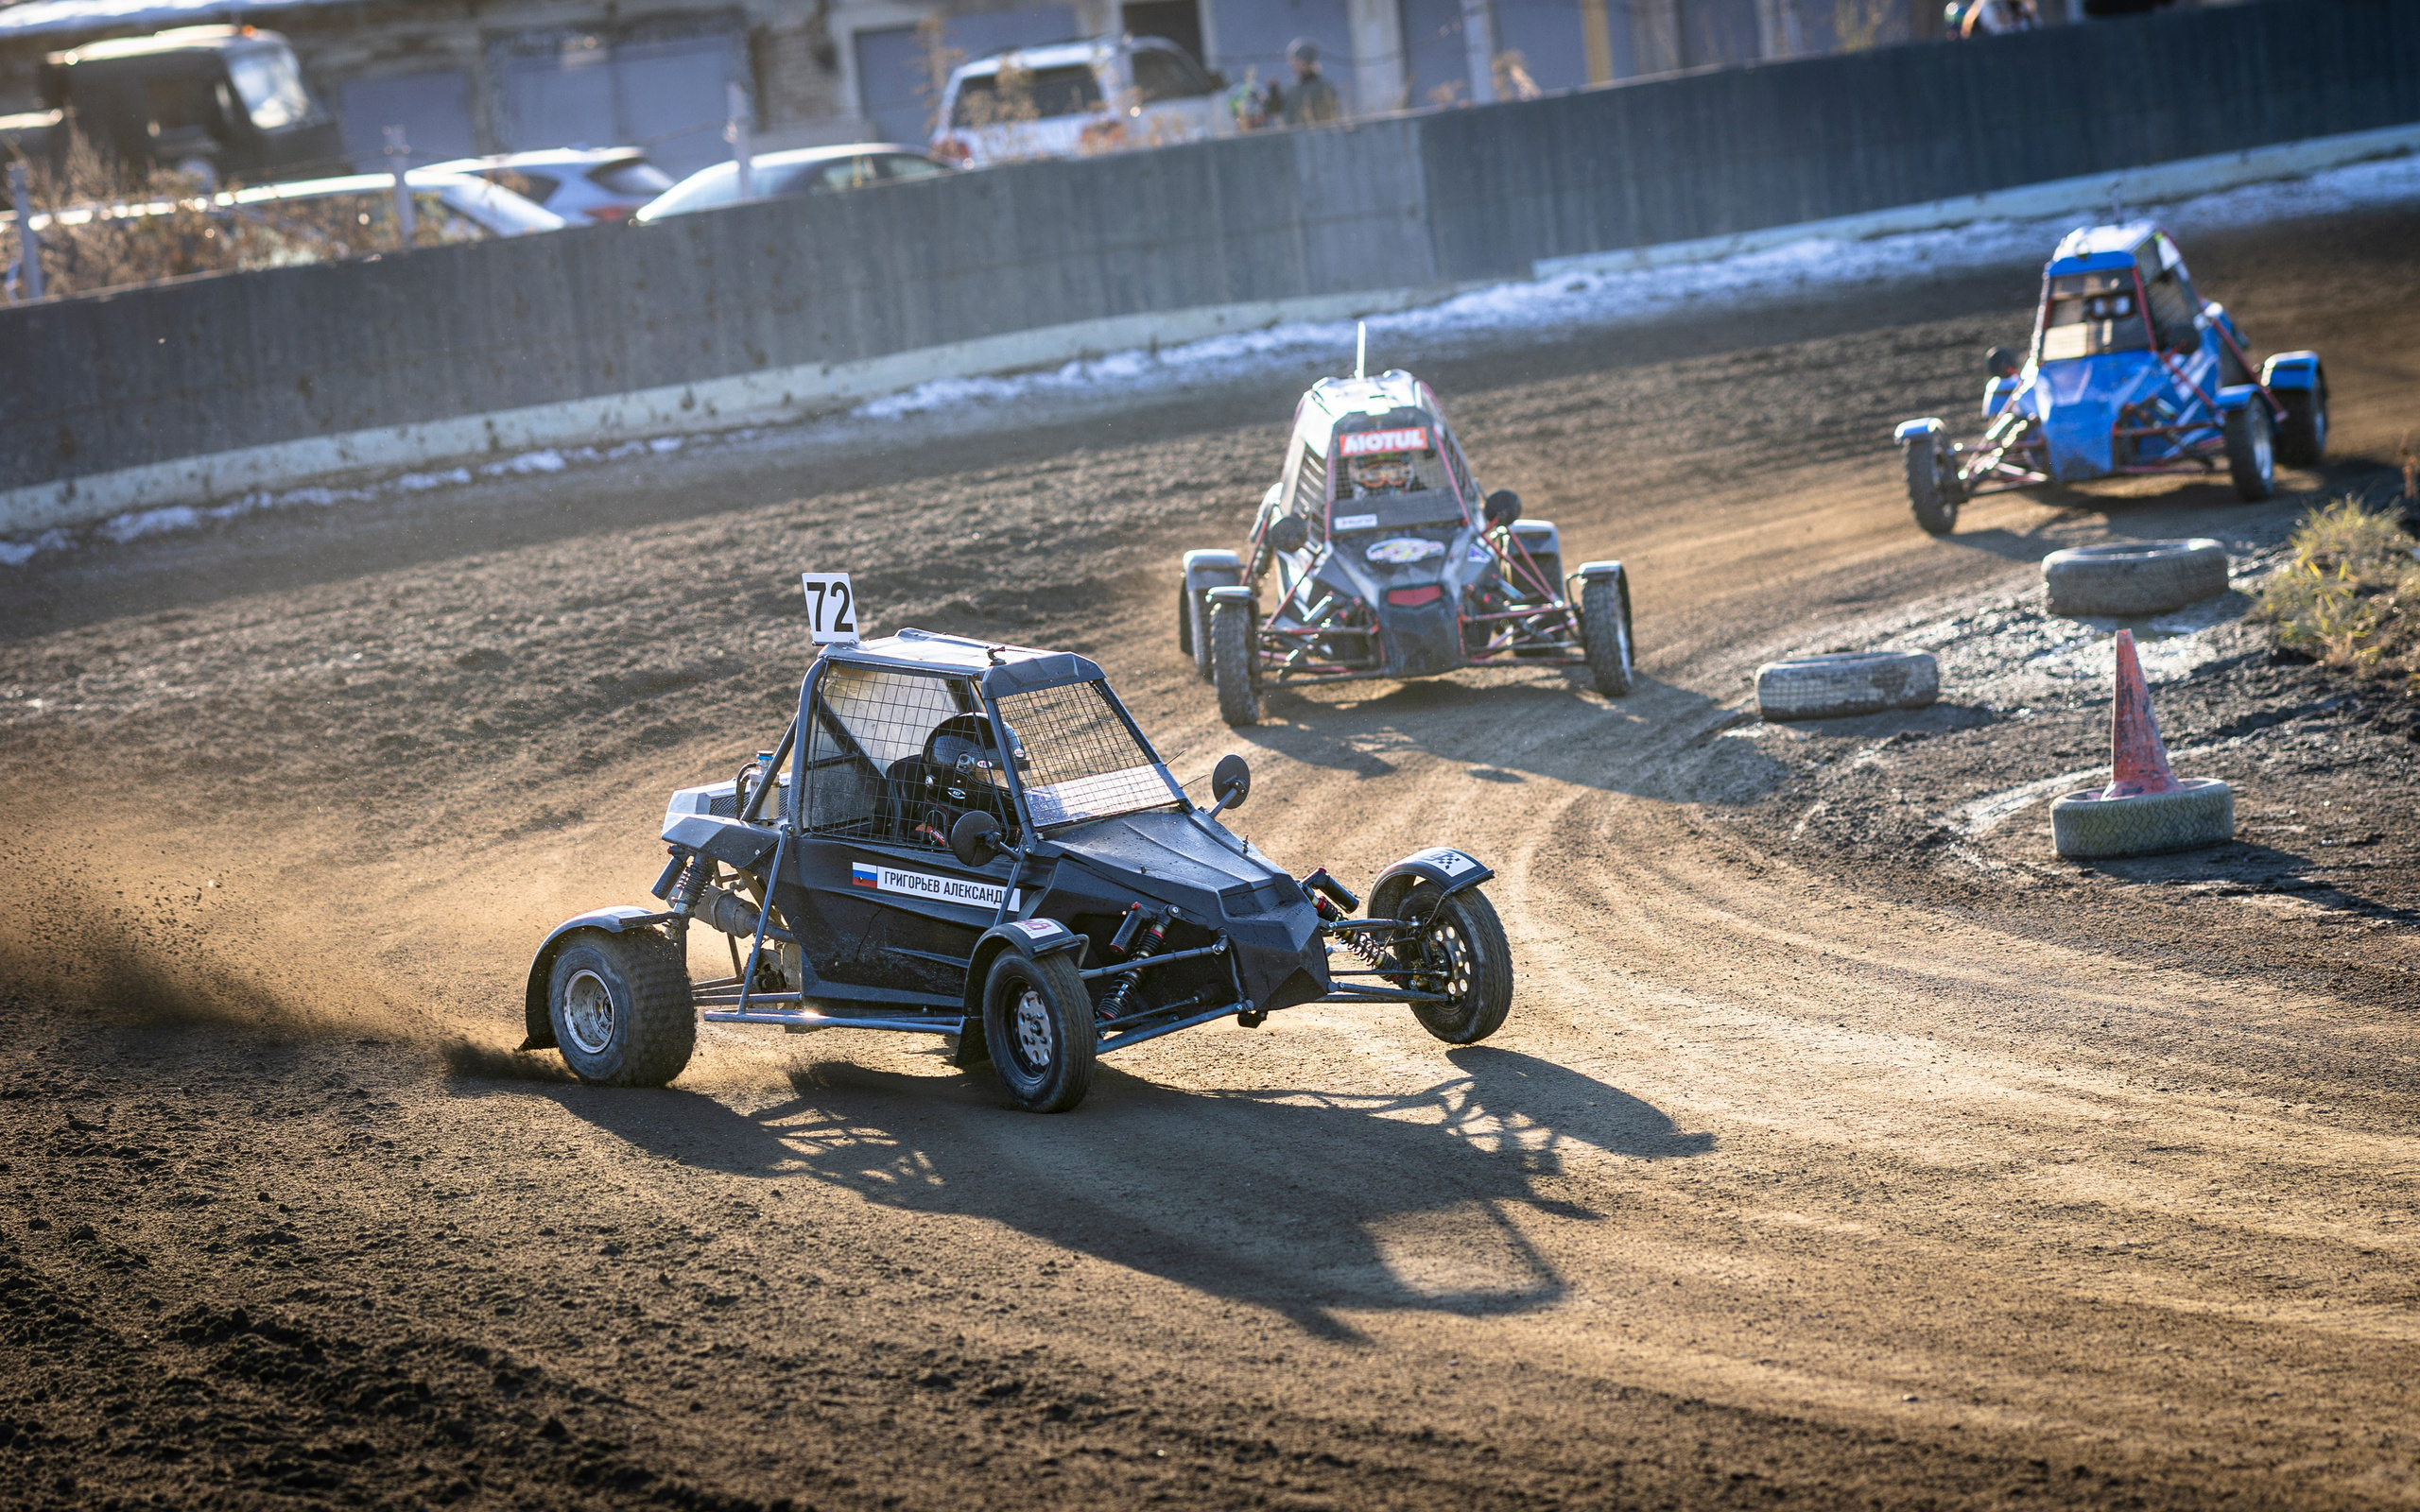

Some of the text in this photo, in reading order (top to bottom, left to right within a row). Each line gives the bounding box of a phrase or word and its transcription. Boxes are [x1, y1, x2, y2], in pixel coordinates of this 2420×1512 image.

[1343, 429, 1424, 453] MOTUL
[806, 581, 854, 632] 72
[884, 871, 1006, 904] ГРИГОРЬЕВ АЛЕКСАНД
